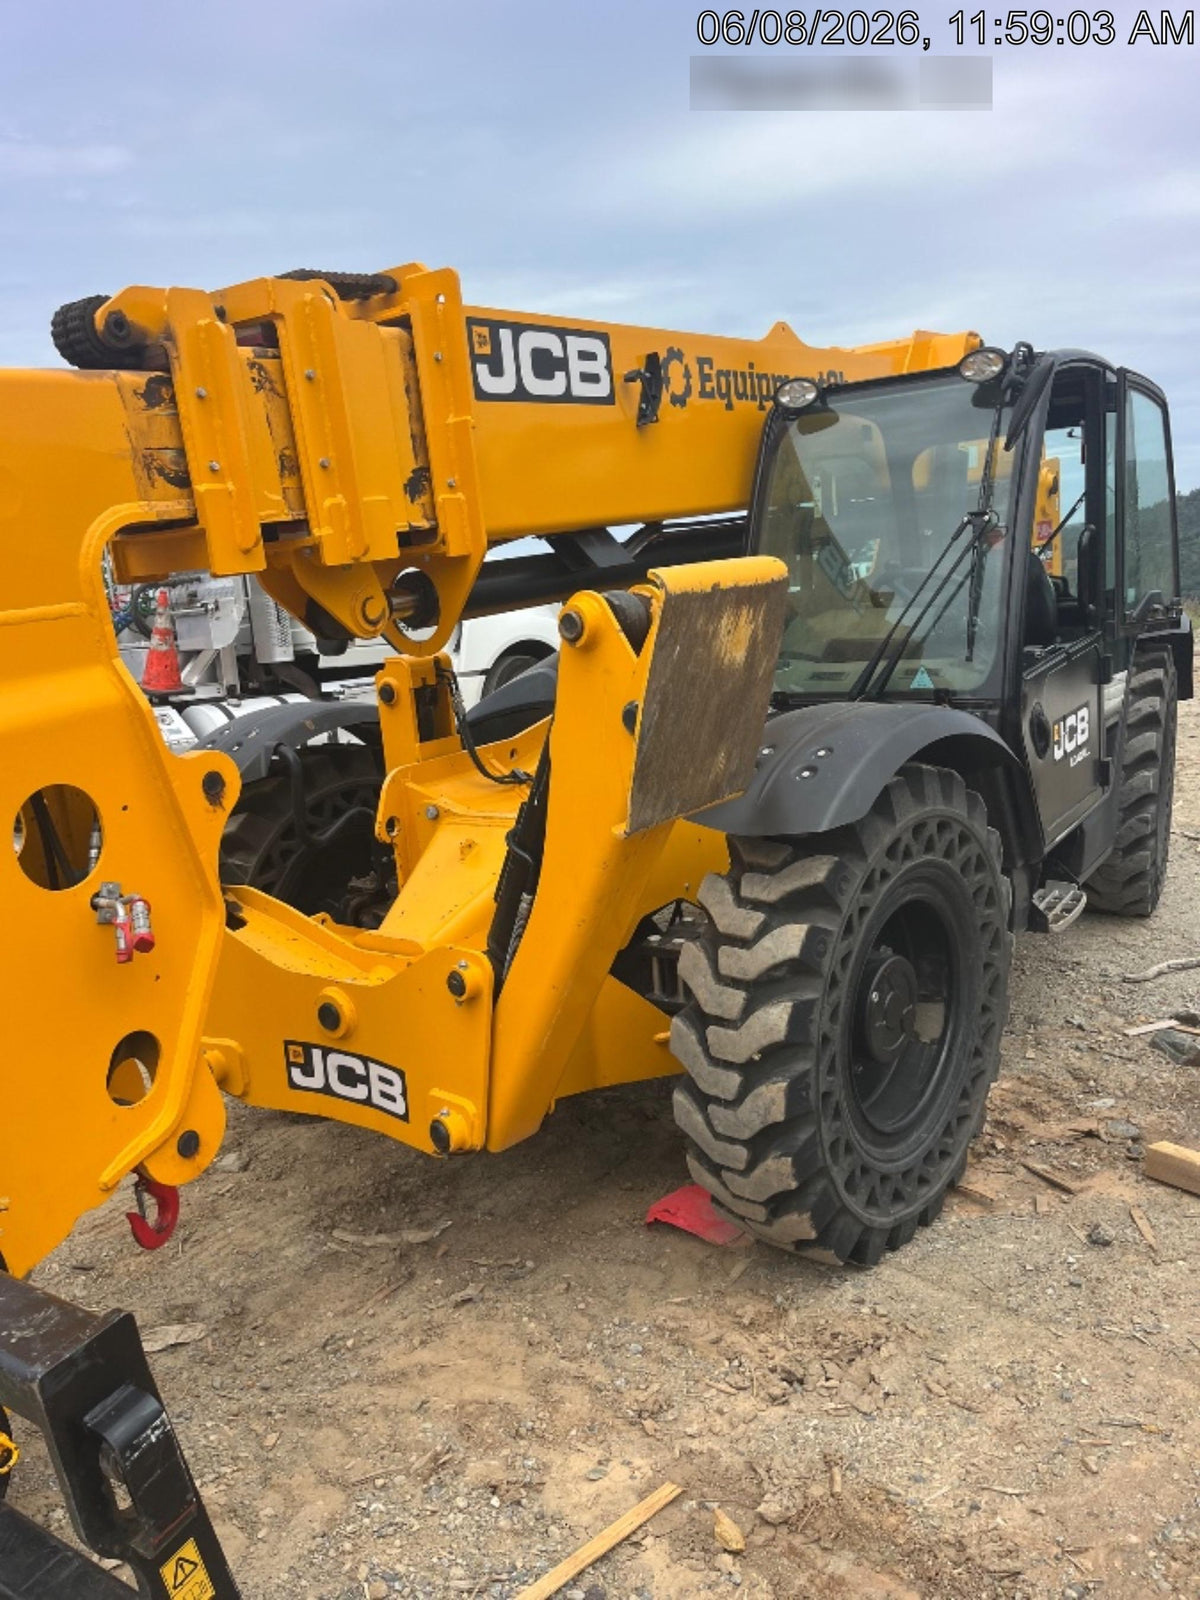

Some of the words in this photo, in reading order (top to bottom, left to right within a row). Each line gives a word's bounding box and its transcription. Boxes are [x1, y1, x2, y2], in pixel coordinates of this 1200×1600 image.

[476, 328, 611, 398] JCB
[1053, 706, 1090, 762] JCB
[290, 1047, 407, 1116] JCB
